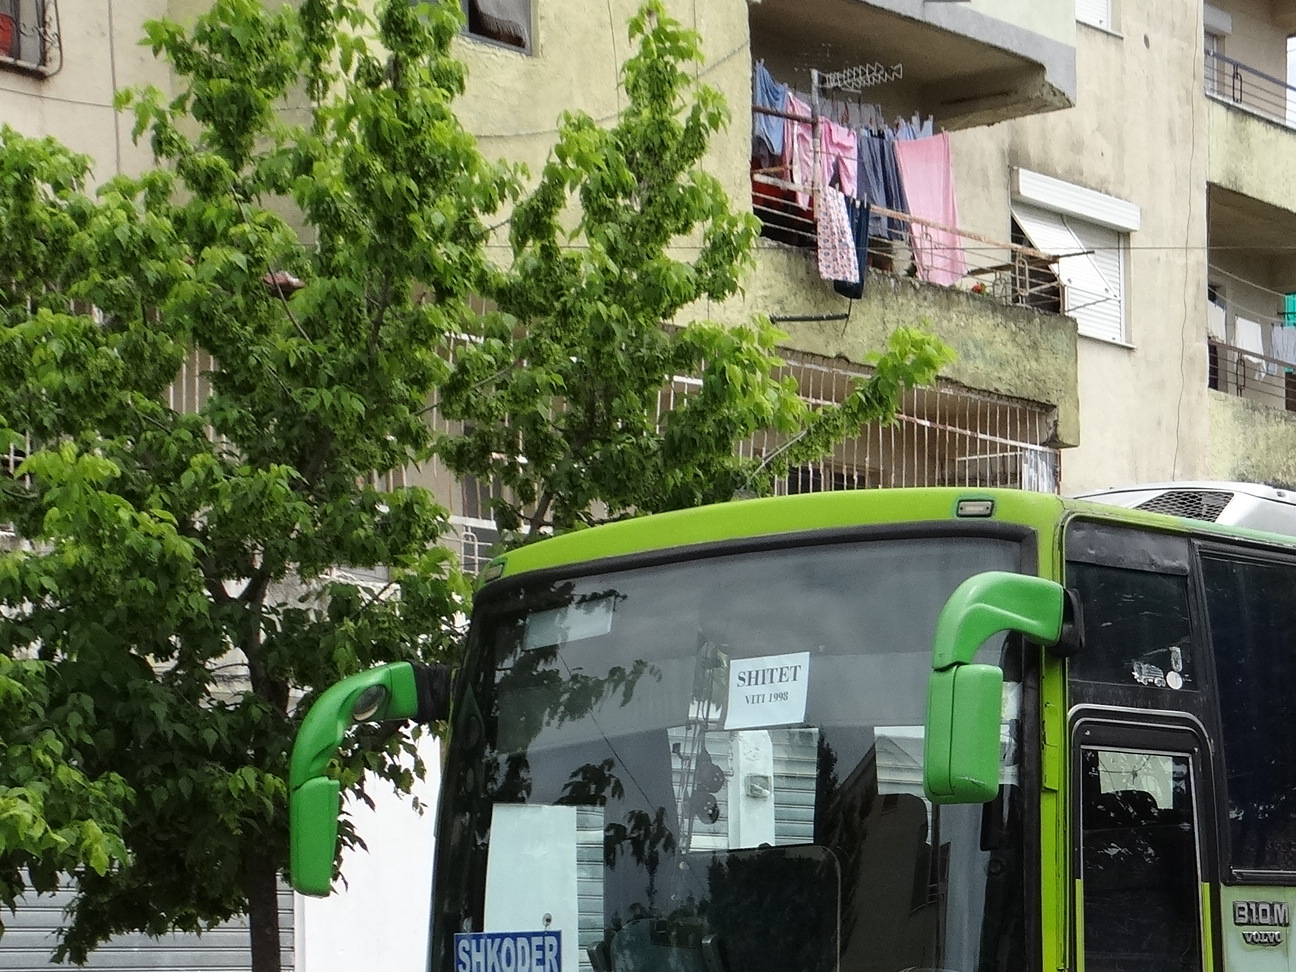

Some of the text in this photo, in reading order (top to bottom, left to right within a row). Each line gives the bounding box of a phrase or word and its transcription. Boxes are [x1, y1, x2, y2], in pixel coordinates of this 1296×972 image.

[737, 665, 802, 687] SHITET
[745, 691, 789, 704] VITI 1998
[1234, 901, 1290, 926] B10M
[1242, 931, 1283, 945] VOLVO
